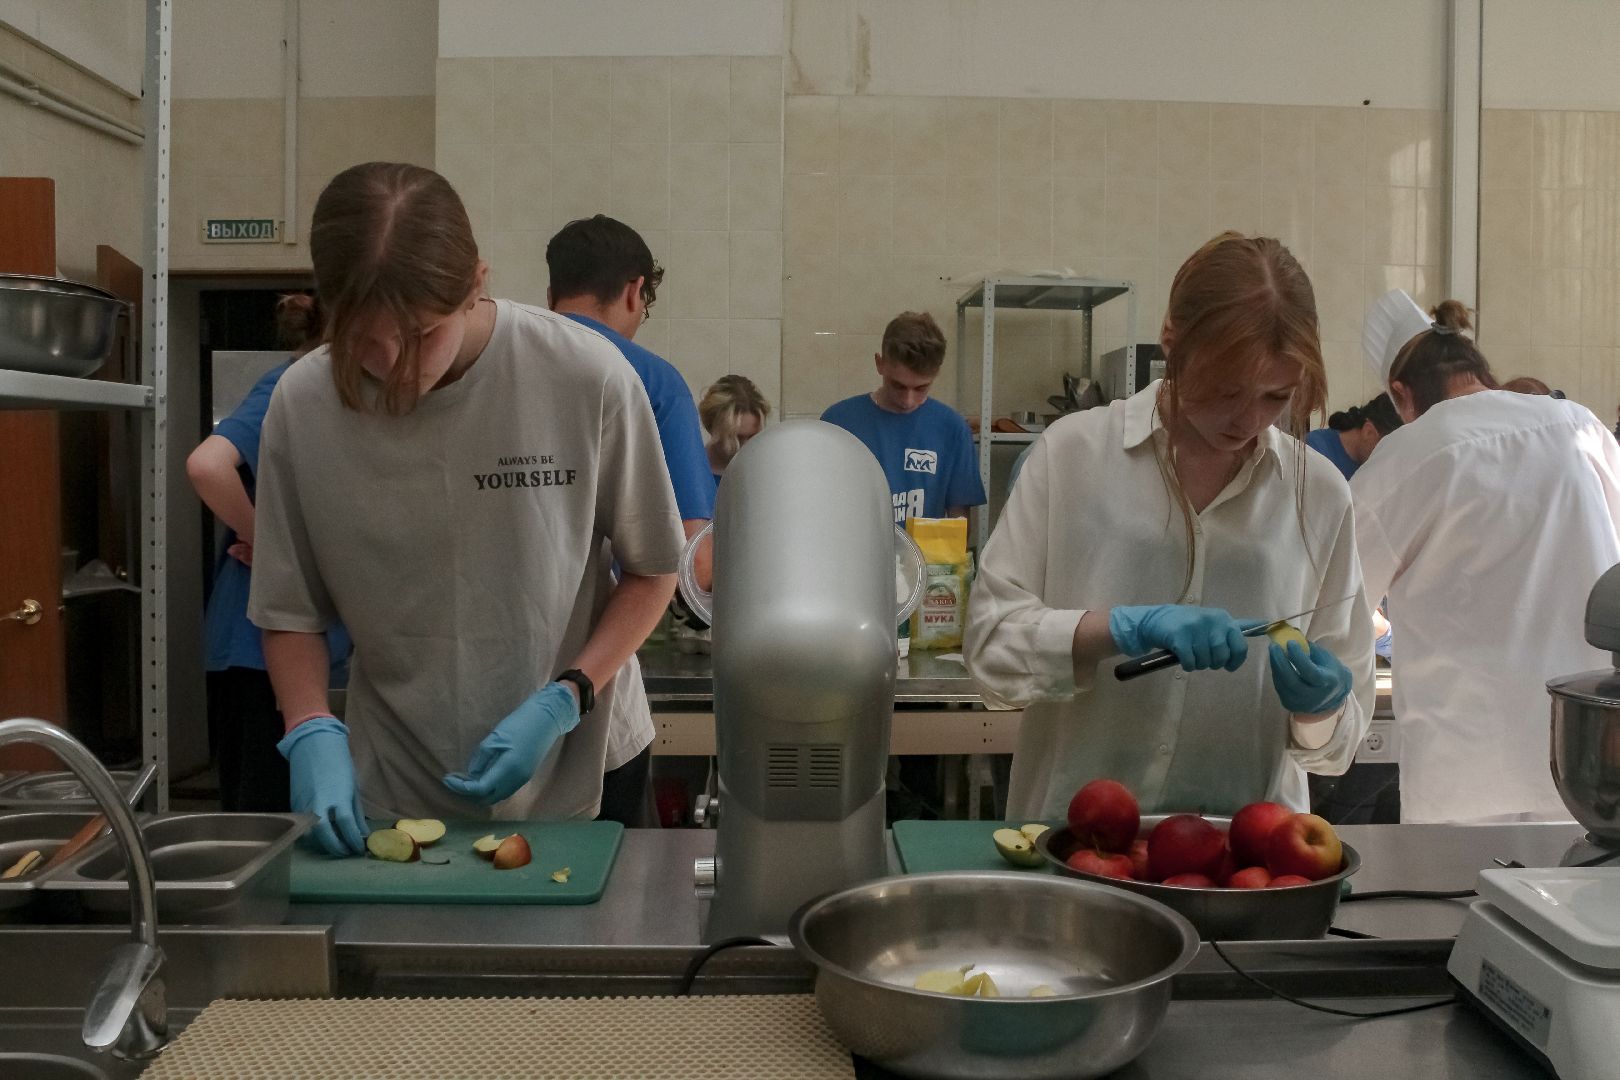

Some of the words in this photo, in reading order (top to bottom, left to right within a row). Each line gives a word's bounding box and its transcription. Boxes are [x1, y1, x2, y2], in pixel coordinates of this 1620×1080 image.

[211, 222, 273, 238] ВЫХОД
[498, 456, 537, 466] ALWAYS
[541, 455, 555, 464] BE
[473, 469, 577, 490] YOURSELF
[924, 615, 955, 624] МУКА
